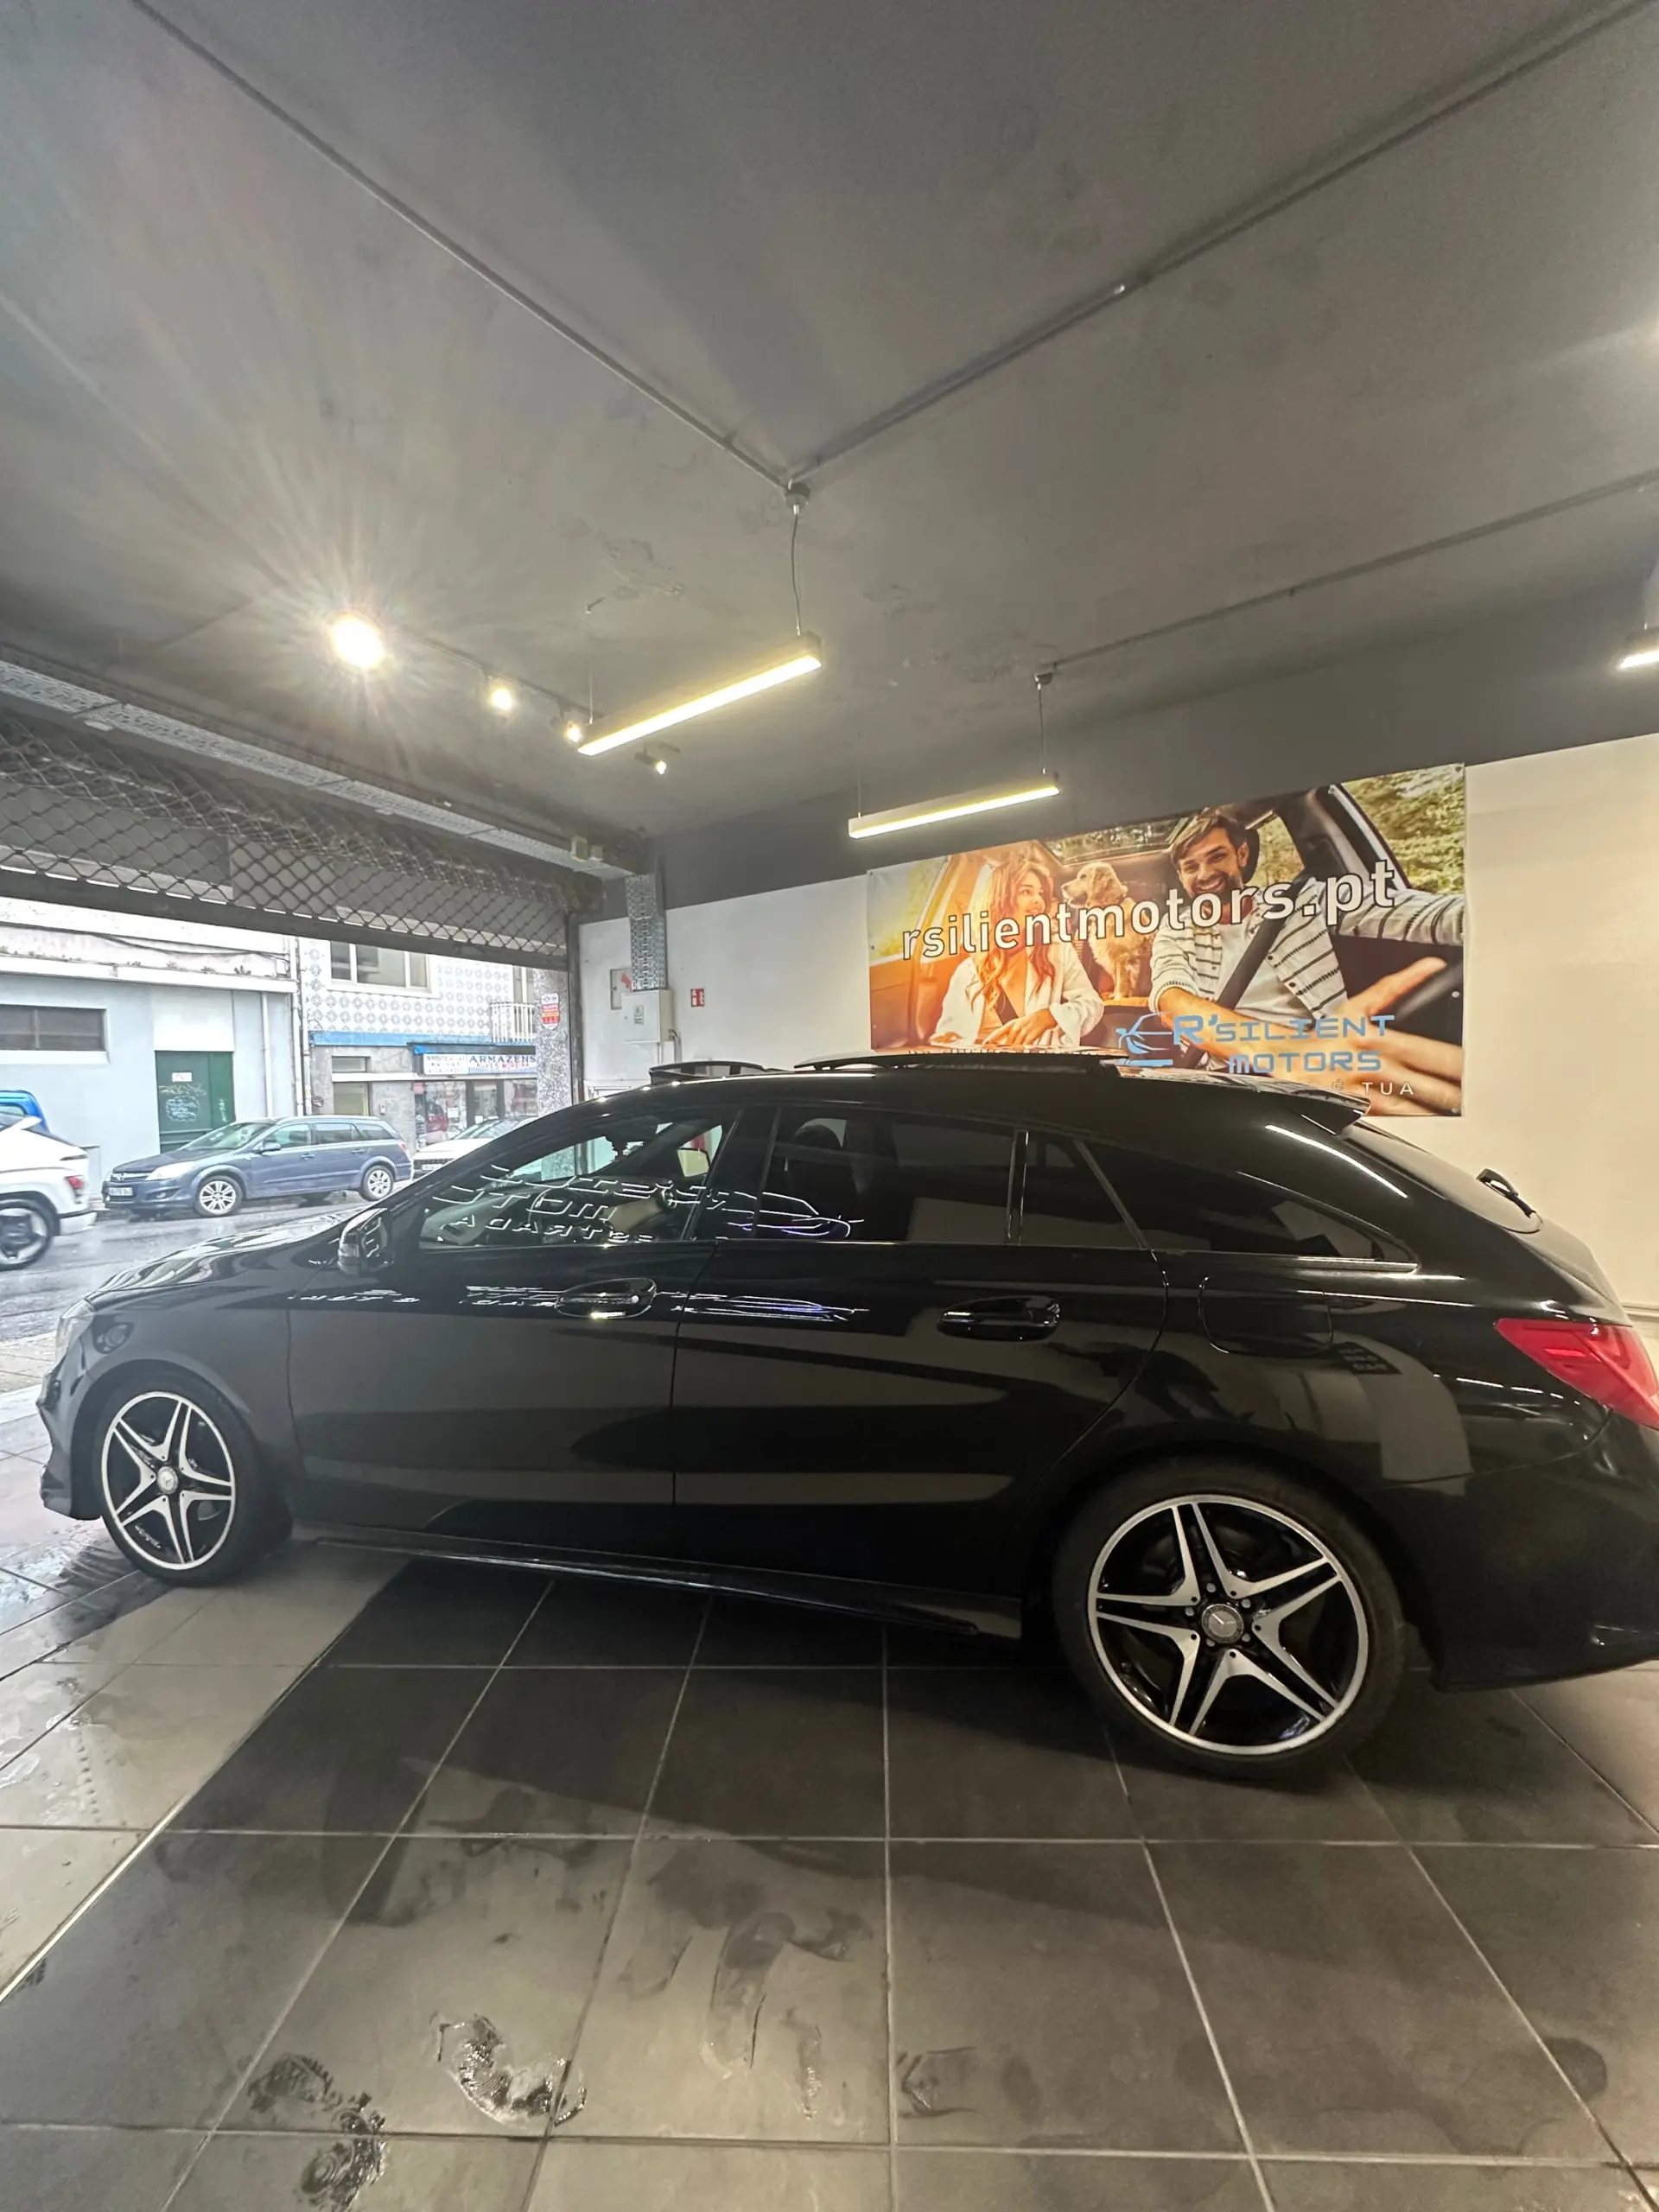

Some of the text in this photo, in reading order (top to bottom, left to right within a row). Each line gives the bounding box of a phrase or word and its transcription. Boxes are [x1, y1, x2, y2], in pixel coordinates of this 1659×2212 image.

[901, 858, 1395, 960] rsilientmotors.pt
[1173, 1014, 1395, 1045] R'SILIENT
[1229, 1050, 1382, 1073] MOTORS
[1362, 1082, 1414, 1096] TUA
